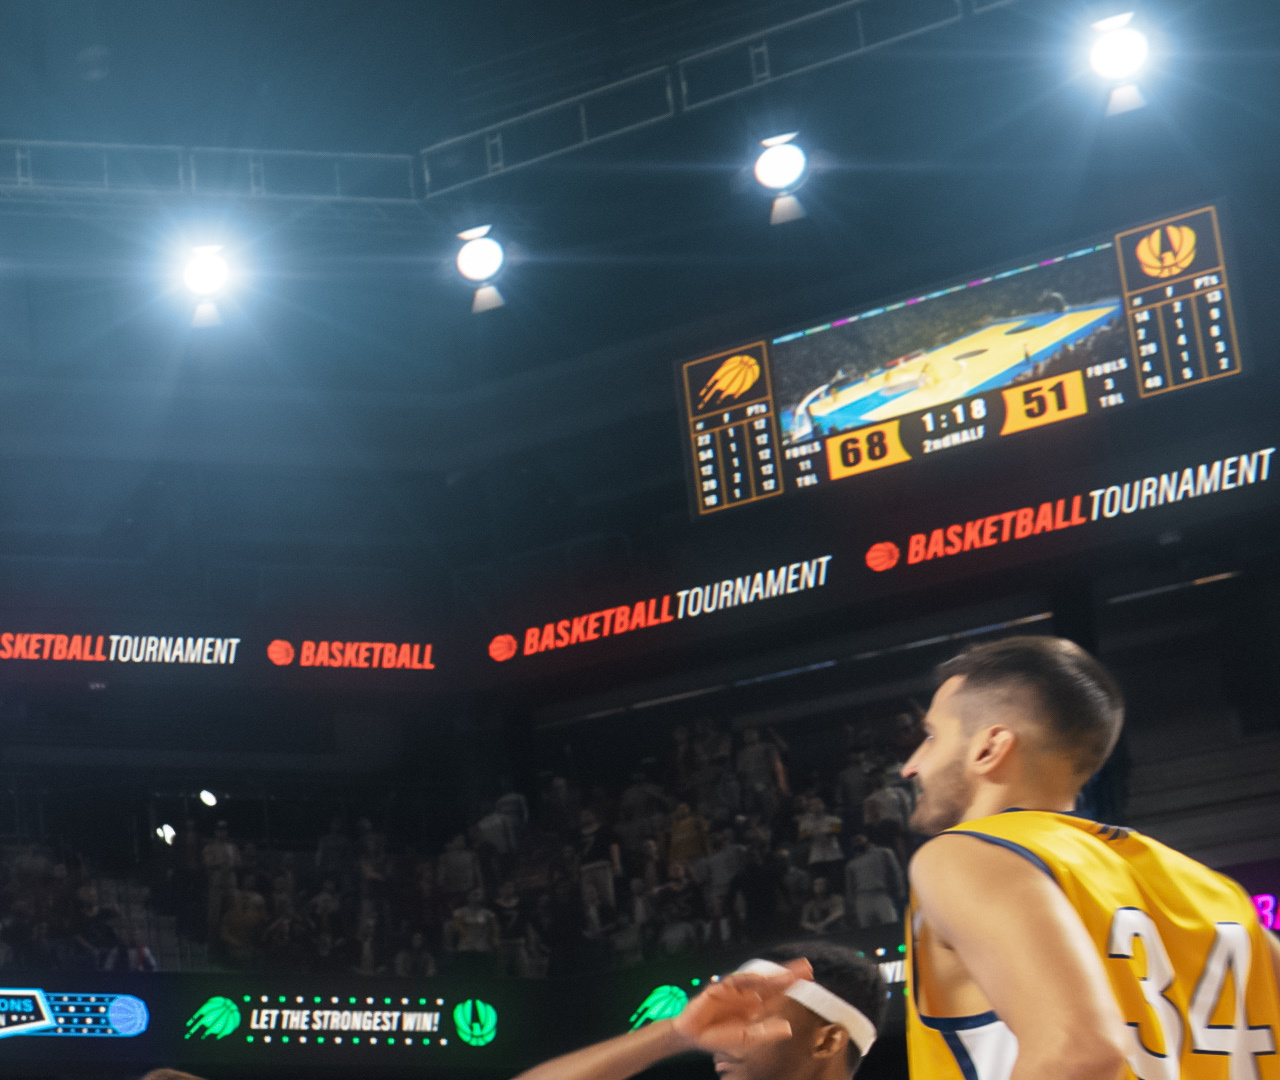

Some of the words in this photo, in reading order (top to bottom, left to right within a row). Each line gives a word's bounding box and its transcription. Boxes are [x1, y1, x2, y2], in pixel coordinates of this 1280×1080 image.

[1087, 358, 1129, 378] FOULS
[922, 398, 988, 432] 1:18
[1022, 380, 1069, 419] 51
[785, 441, 822, 460] FOULS
[840, 430, 889, 468] 68
[907, 494, 1088, 565] BASKETBALL
[1089, 447, 1275, 521] TOURNAMENT
[523, 594, 674, 656] BASKETBALL
[677, 555, 831, 619] TOURNAMENT
[109, 634, 242, 664] TOURNAMENT
[299, 640, 435, 670] BASKETBALL
[250, 1008, 280, 1030] LET
[281, 1009, 311, 1031] THE
[311, 1010, 402, 1032] STRONGEST
[401, 1011, 441, 1032] WIN!
